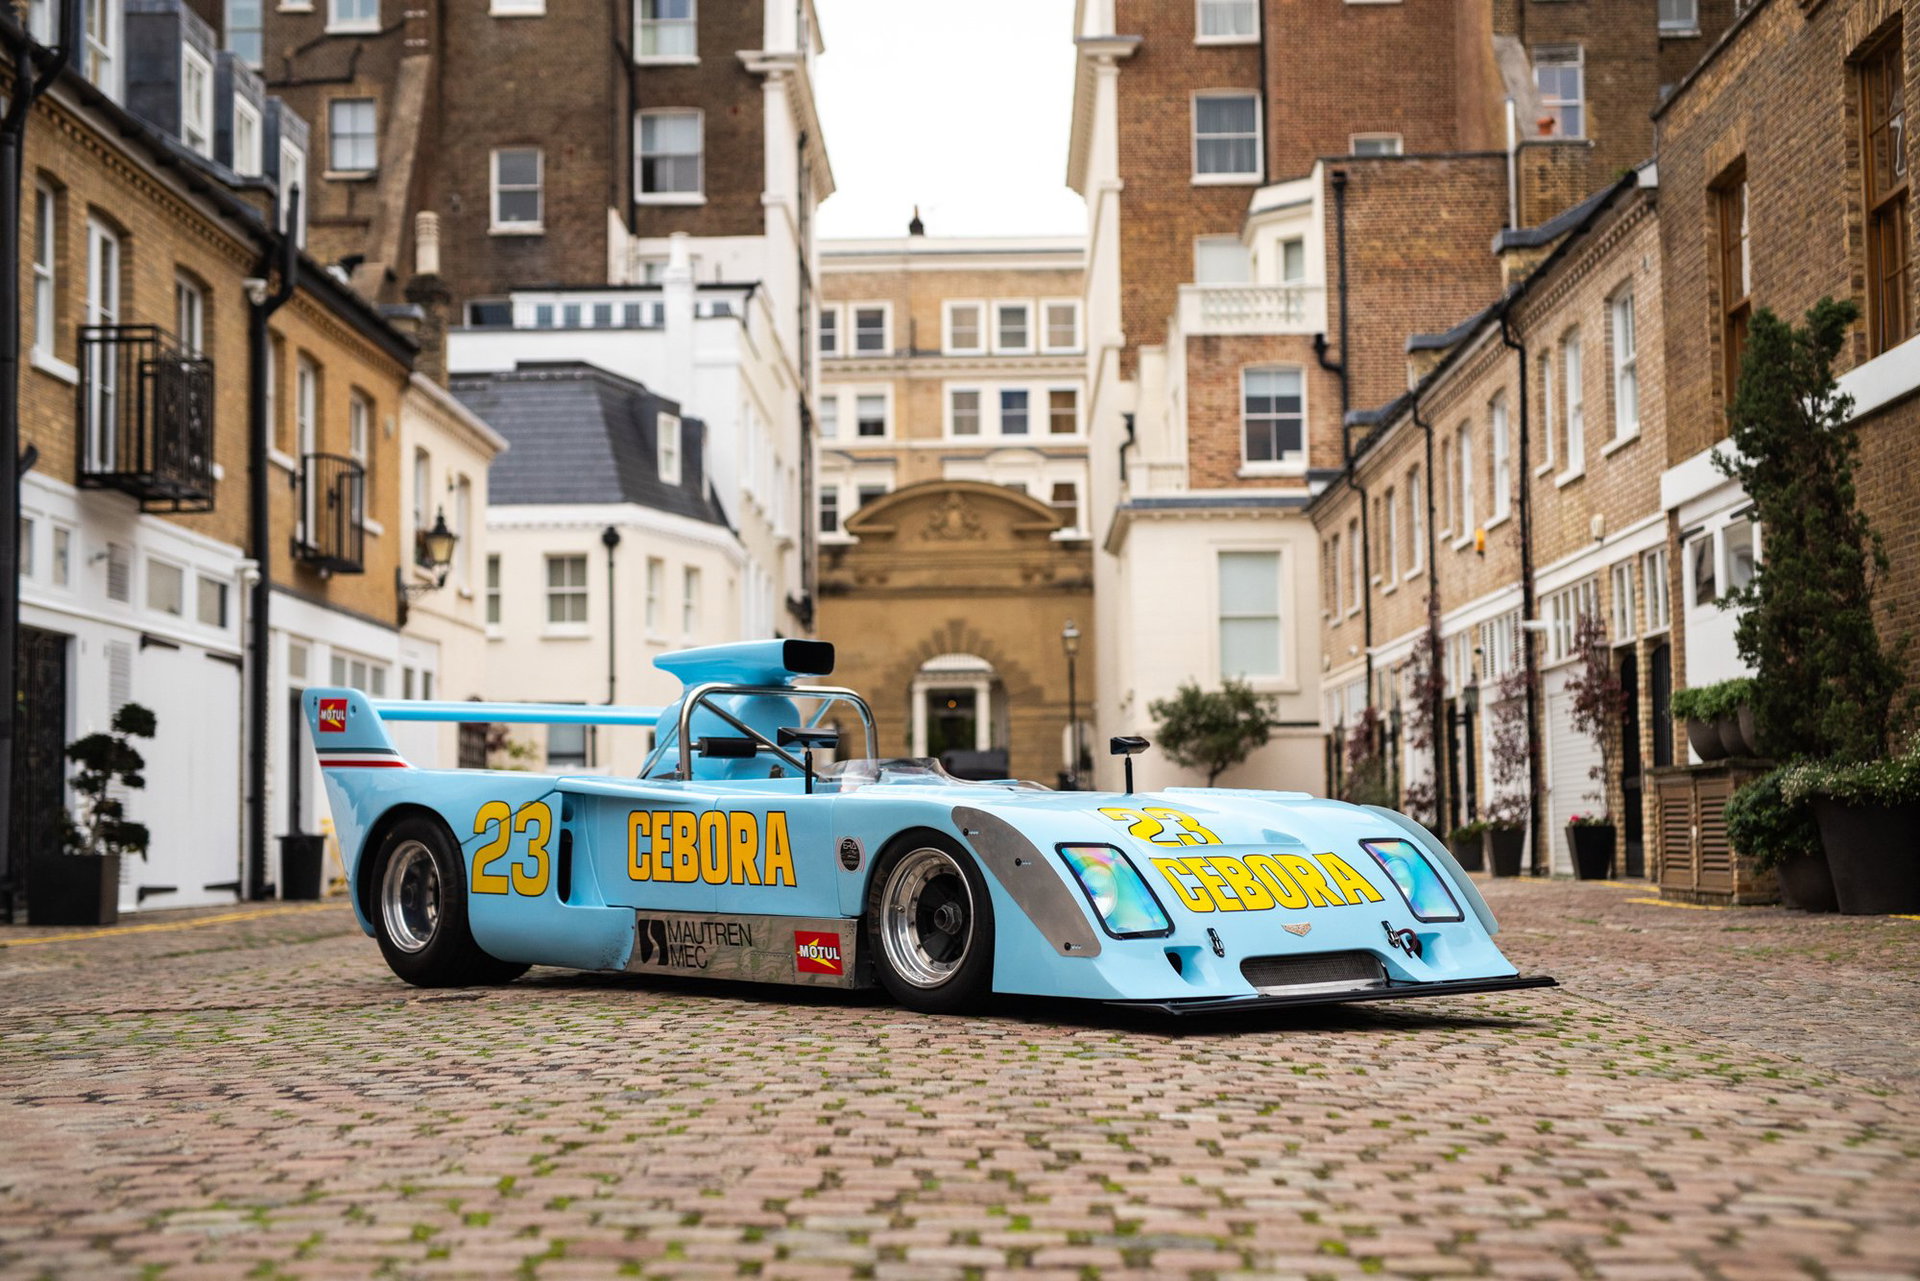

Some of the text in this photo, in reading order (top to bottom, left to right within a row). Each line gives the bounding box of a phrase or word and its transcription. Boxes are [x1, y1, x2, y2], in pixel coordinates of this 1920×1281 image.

[320, 709, 346, 721] MOTUL
[1097, 806, 1224, 848] 23
[471, 800, 553, 897] 23
[627, 810, 798, 887] CEBORA
[1149, 851, 1386, 913] CEBORA
[667, 920, 753, 947] MAUTREN
[669, 944, 709, 969] MEC
[799, 944, 841, 960] MOTUL
